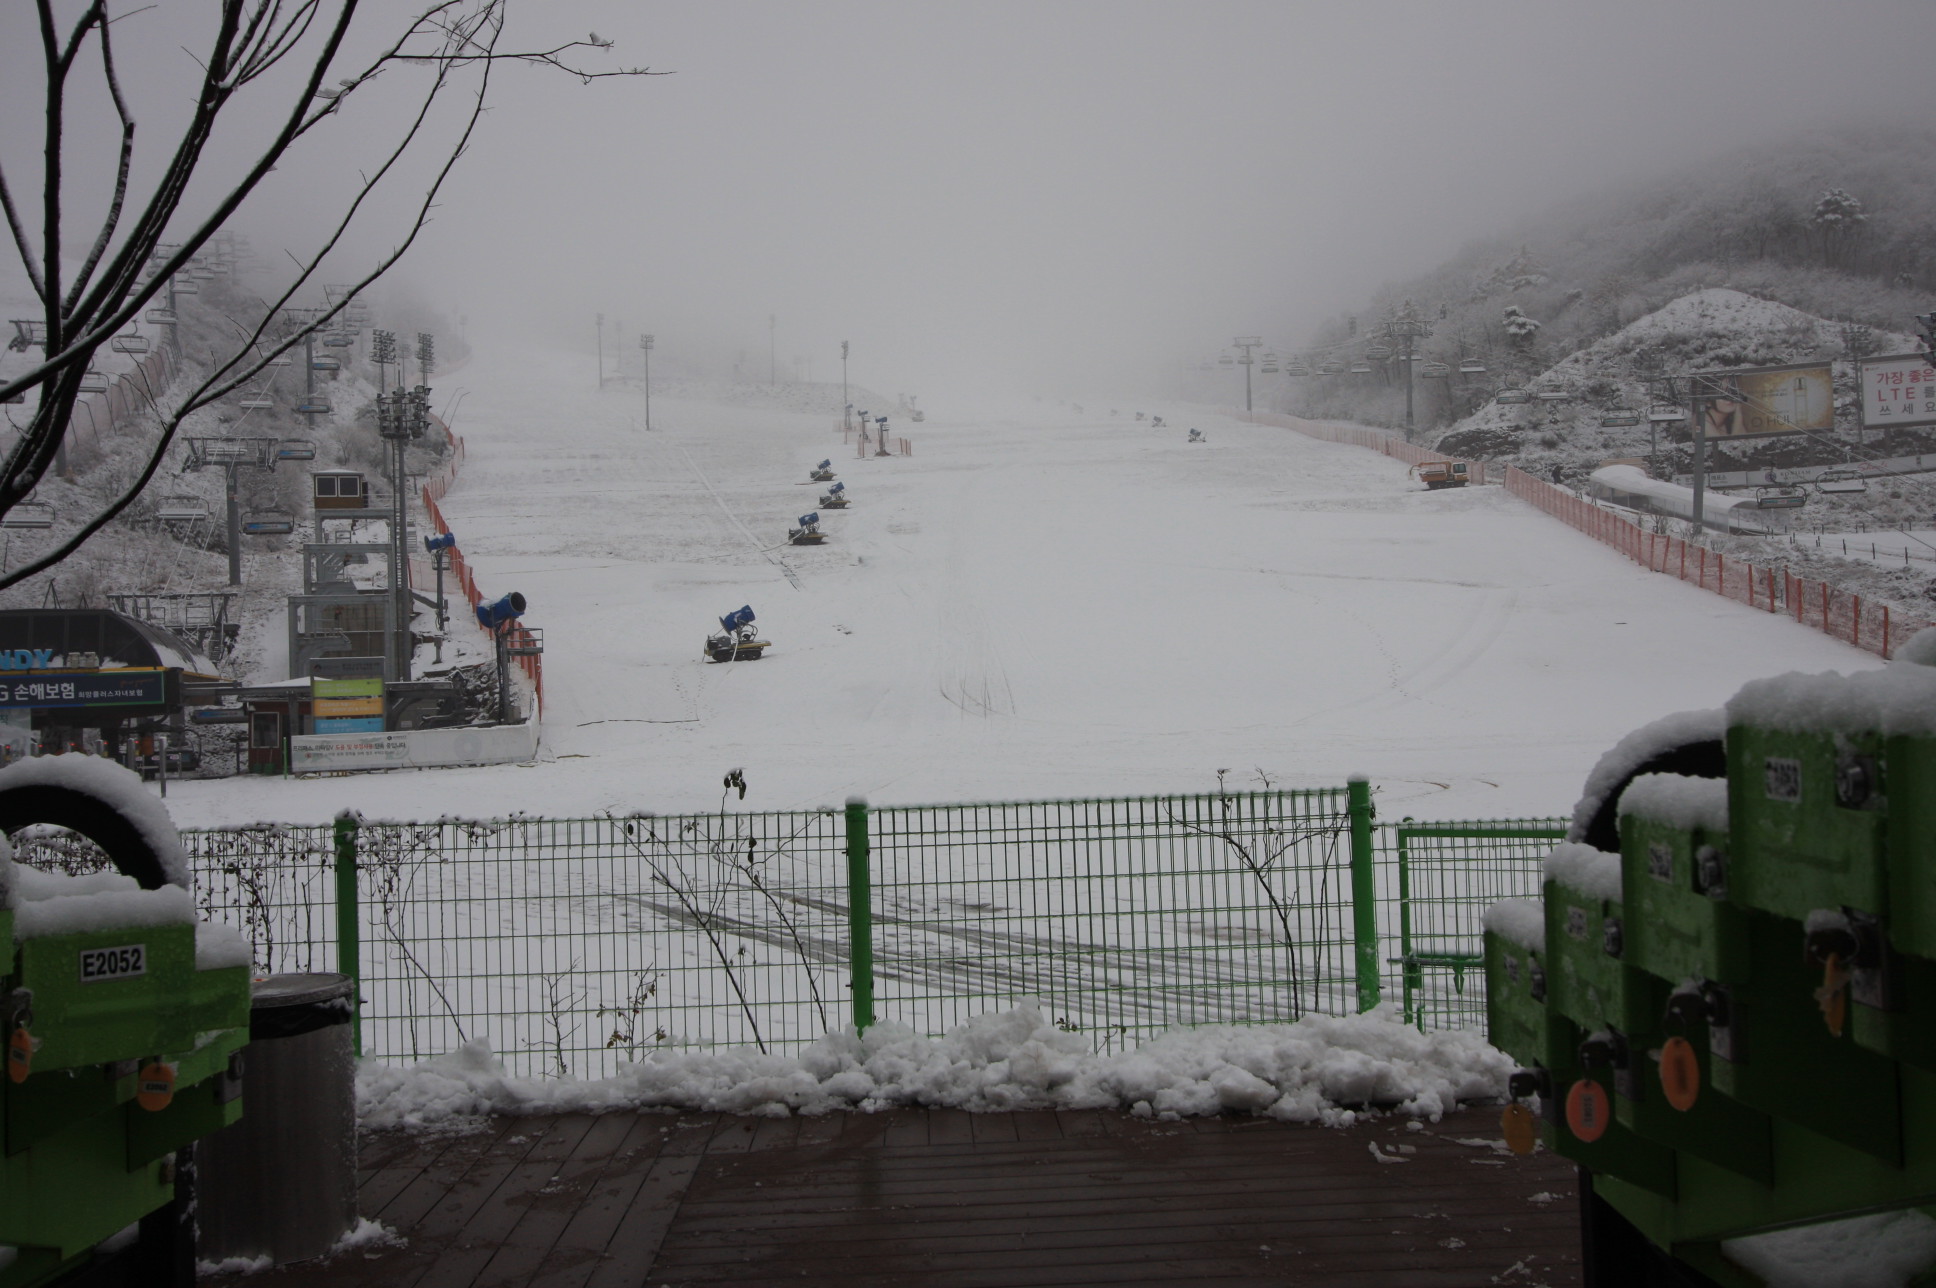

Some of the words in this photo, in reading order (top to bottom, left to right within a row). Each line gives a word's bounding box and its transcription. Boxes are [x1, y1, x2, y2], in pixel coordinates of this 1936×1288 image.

[1876, 371, 1904, 385] 가장
[1908, 368, 1936, 383] 좋은
[14, 682, 75, 701] 손해보험
[83, 948, 142, 977] E2052
